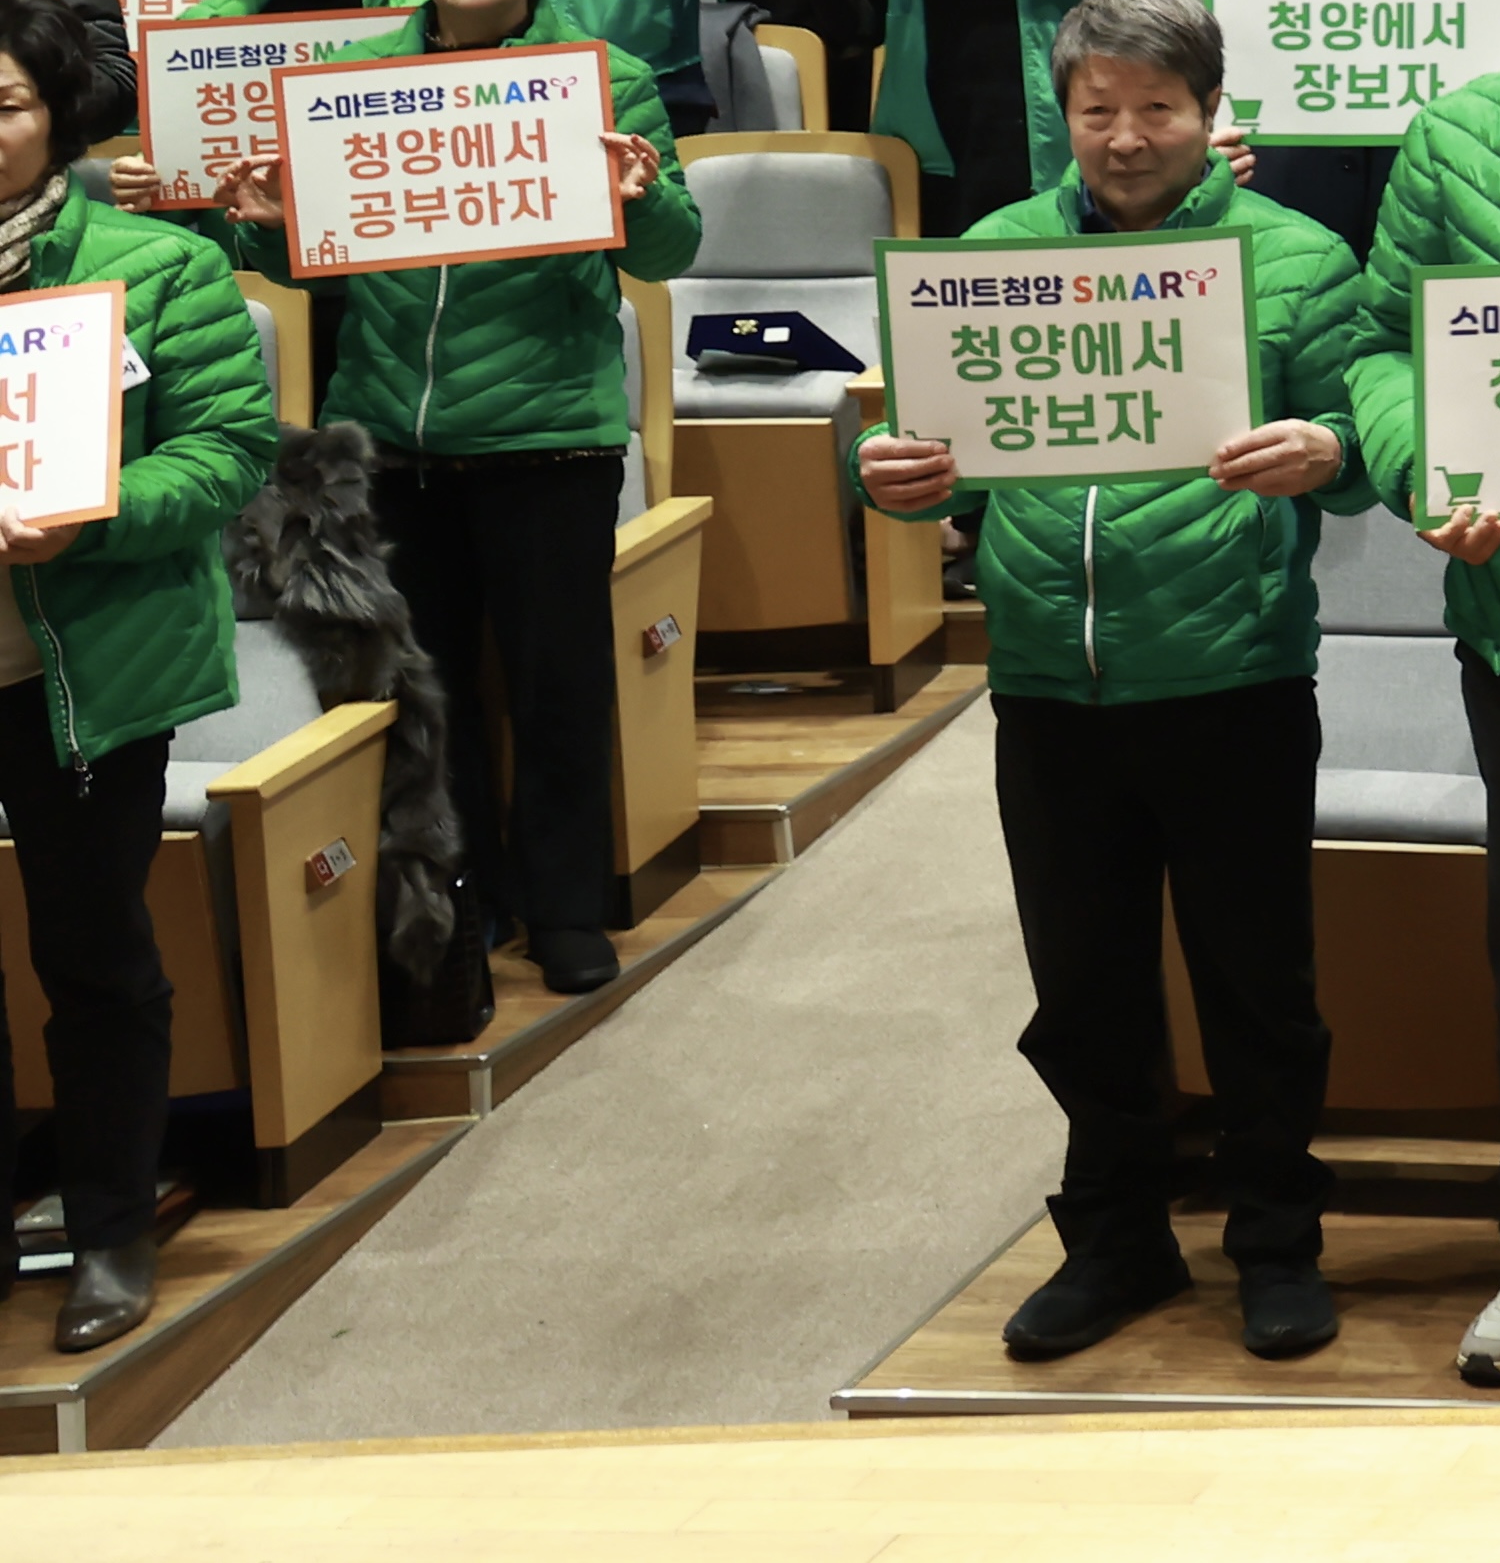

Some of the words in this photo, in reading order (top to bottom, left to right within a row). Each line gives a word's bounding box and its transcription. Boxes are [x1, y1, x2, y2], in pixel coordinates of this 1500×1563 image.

[1268, 1, 1465, 51] 청양에서
[167, 43, 287, 71] 스마트청양
[308, 87, 444, 121] 스마트청양
[1293, 63, 1444, 113] 장보자
[343, 118, 547, 180] 청양에서
[350, 176, 557, 239] 공부하자
[911, 275, 1063, 307] 스마트청양
[951, 318, 1183, 382] 청양에서
[985, 390, 1162, 452] 장보자
